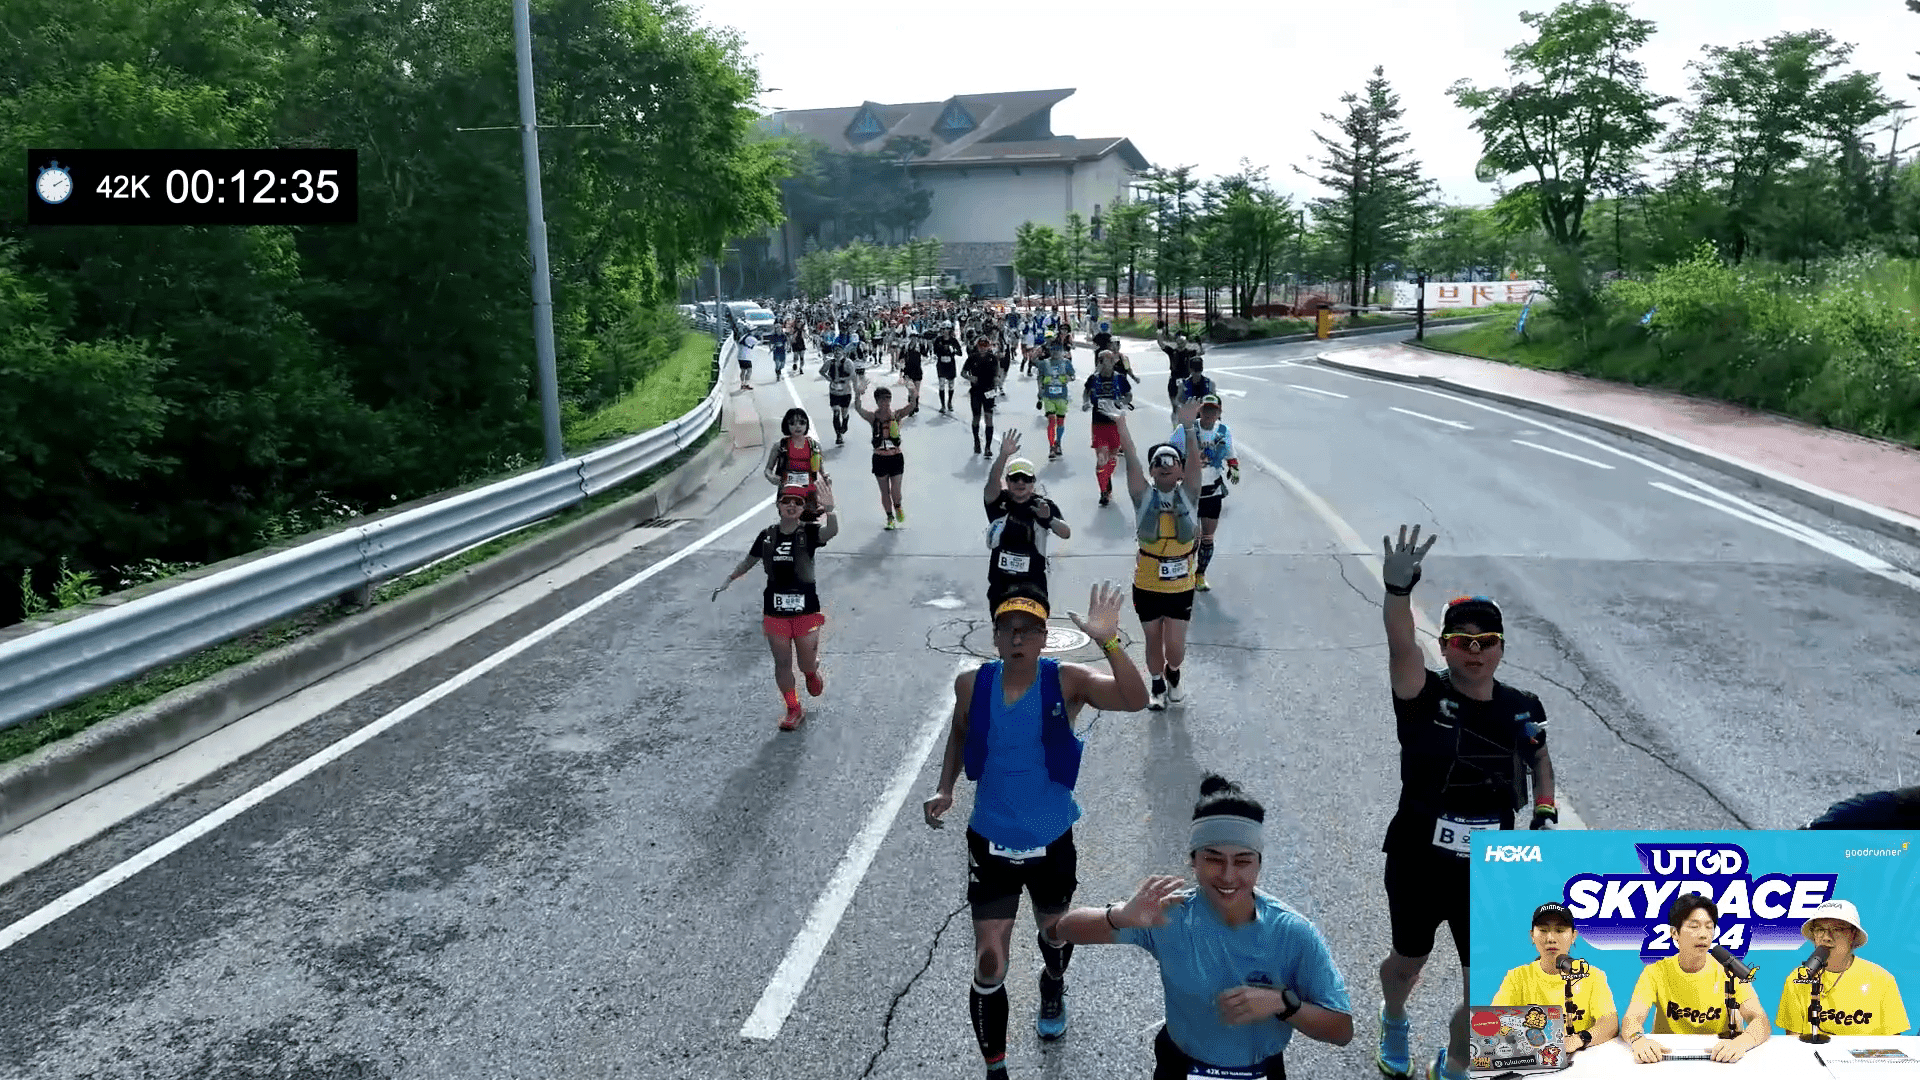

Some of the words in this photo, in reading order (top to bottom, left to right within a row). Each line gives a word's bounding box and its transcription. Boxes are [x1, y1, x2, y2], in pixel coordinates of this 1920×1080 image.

[1439, 827, 1455, 844] B
[1484, 845, 1543, 863] HOKA
[1845, 847, 1902, 859] goodrunner
[1647, 923, 1746, 951] 24
